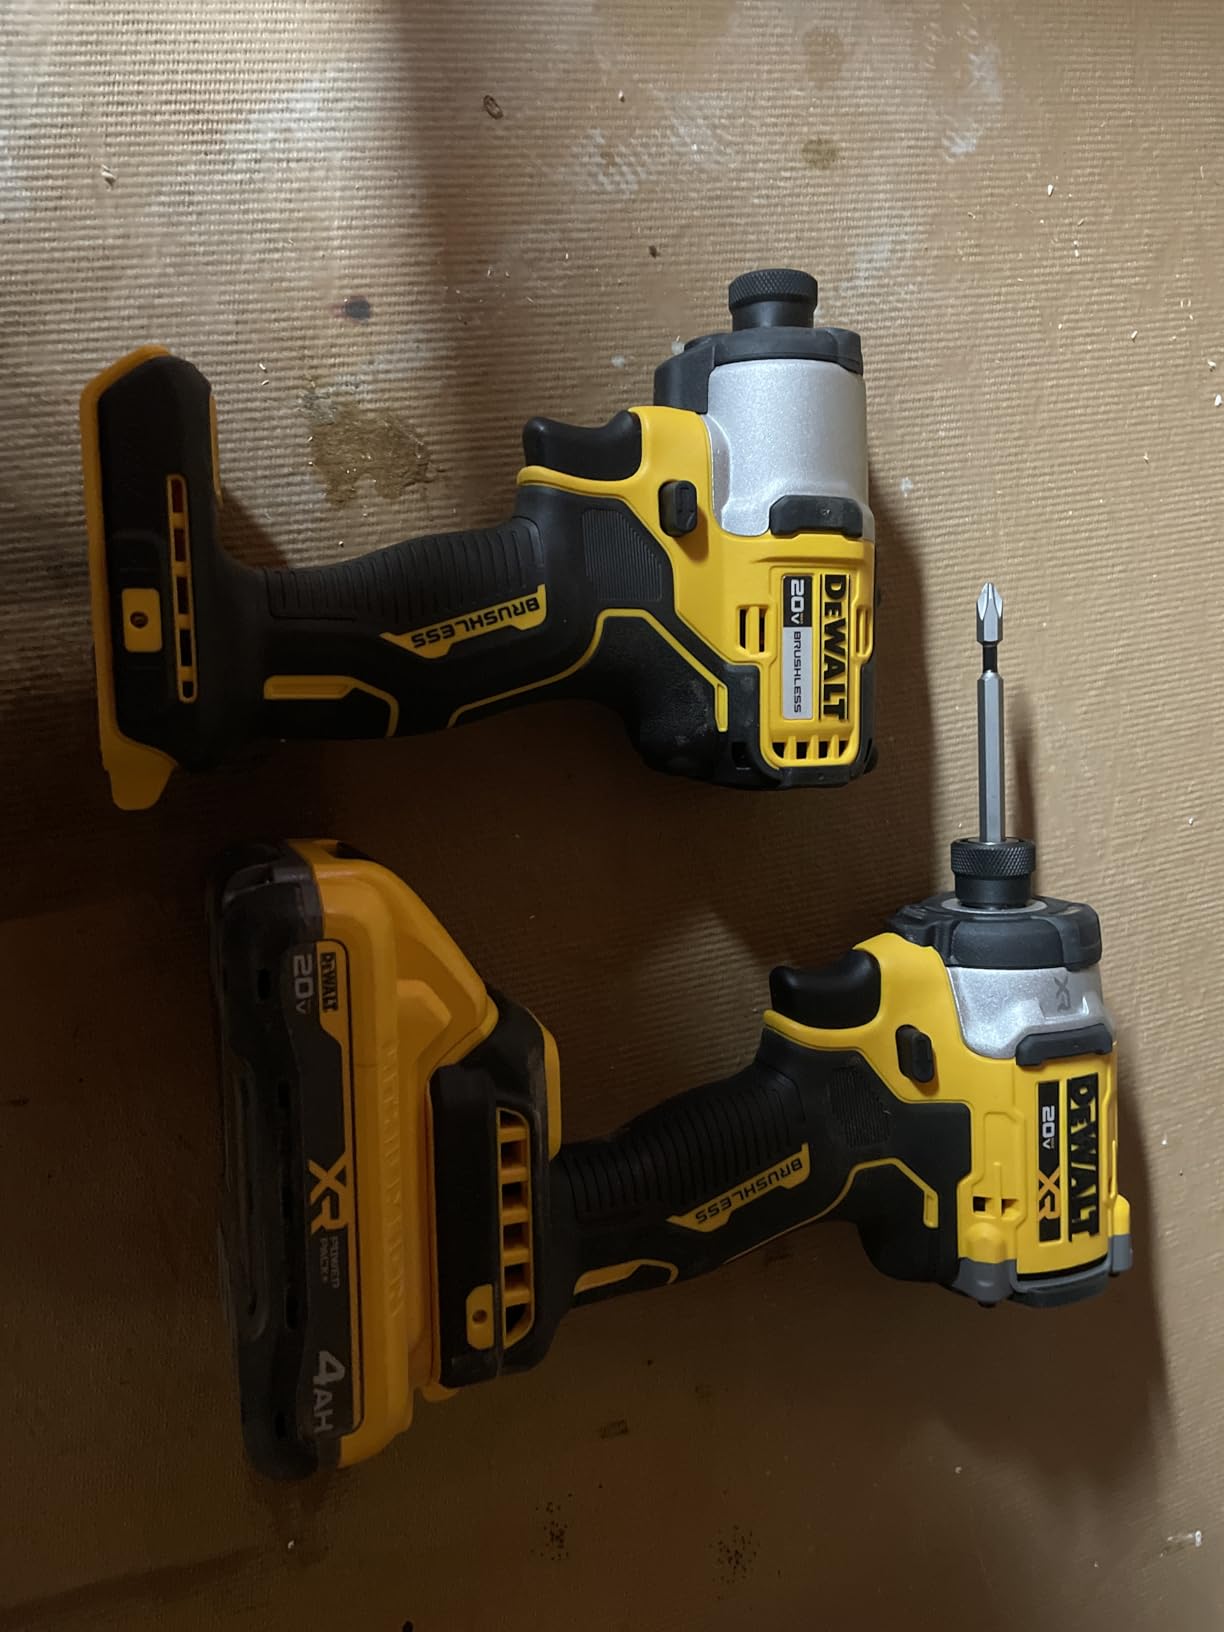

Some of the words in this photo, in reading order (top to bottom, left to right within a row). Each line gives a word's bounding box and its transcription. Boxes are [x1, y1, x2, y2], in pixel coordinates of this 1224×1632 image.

[411, 597, 540, 648] BRUSHLESS
[823, 574, 847, 720] DEWALT
[793, 631, 802, 713] BRUSHLESS
[1053, 975, 1072, 1013] XR
[695, 1158, 804, 1224] BRUSHLESS
[1069, 1073, 1099, 1239] DEWALT
[307, 1156, 348, 1237] XR
[1038, 1166, 1061, 1222] XR
